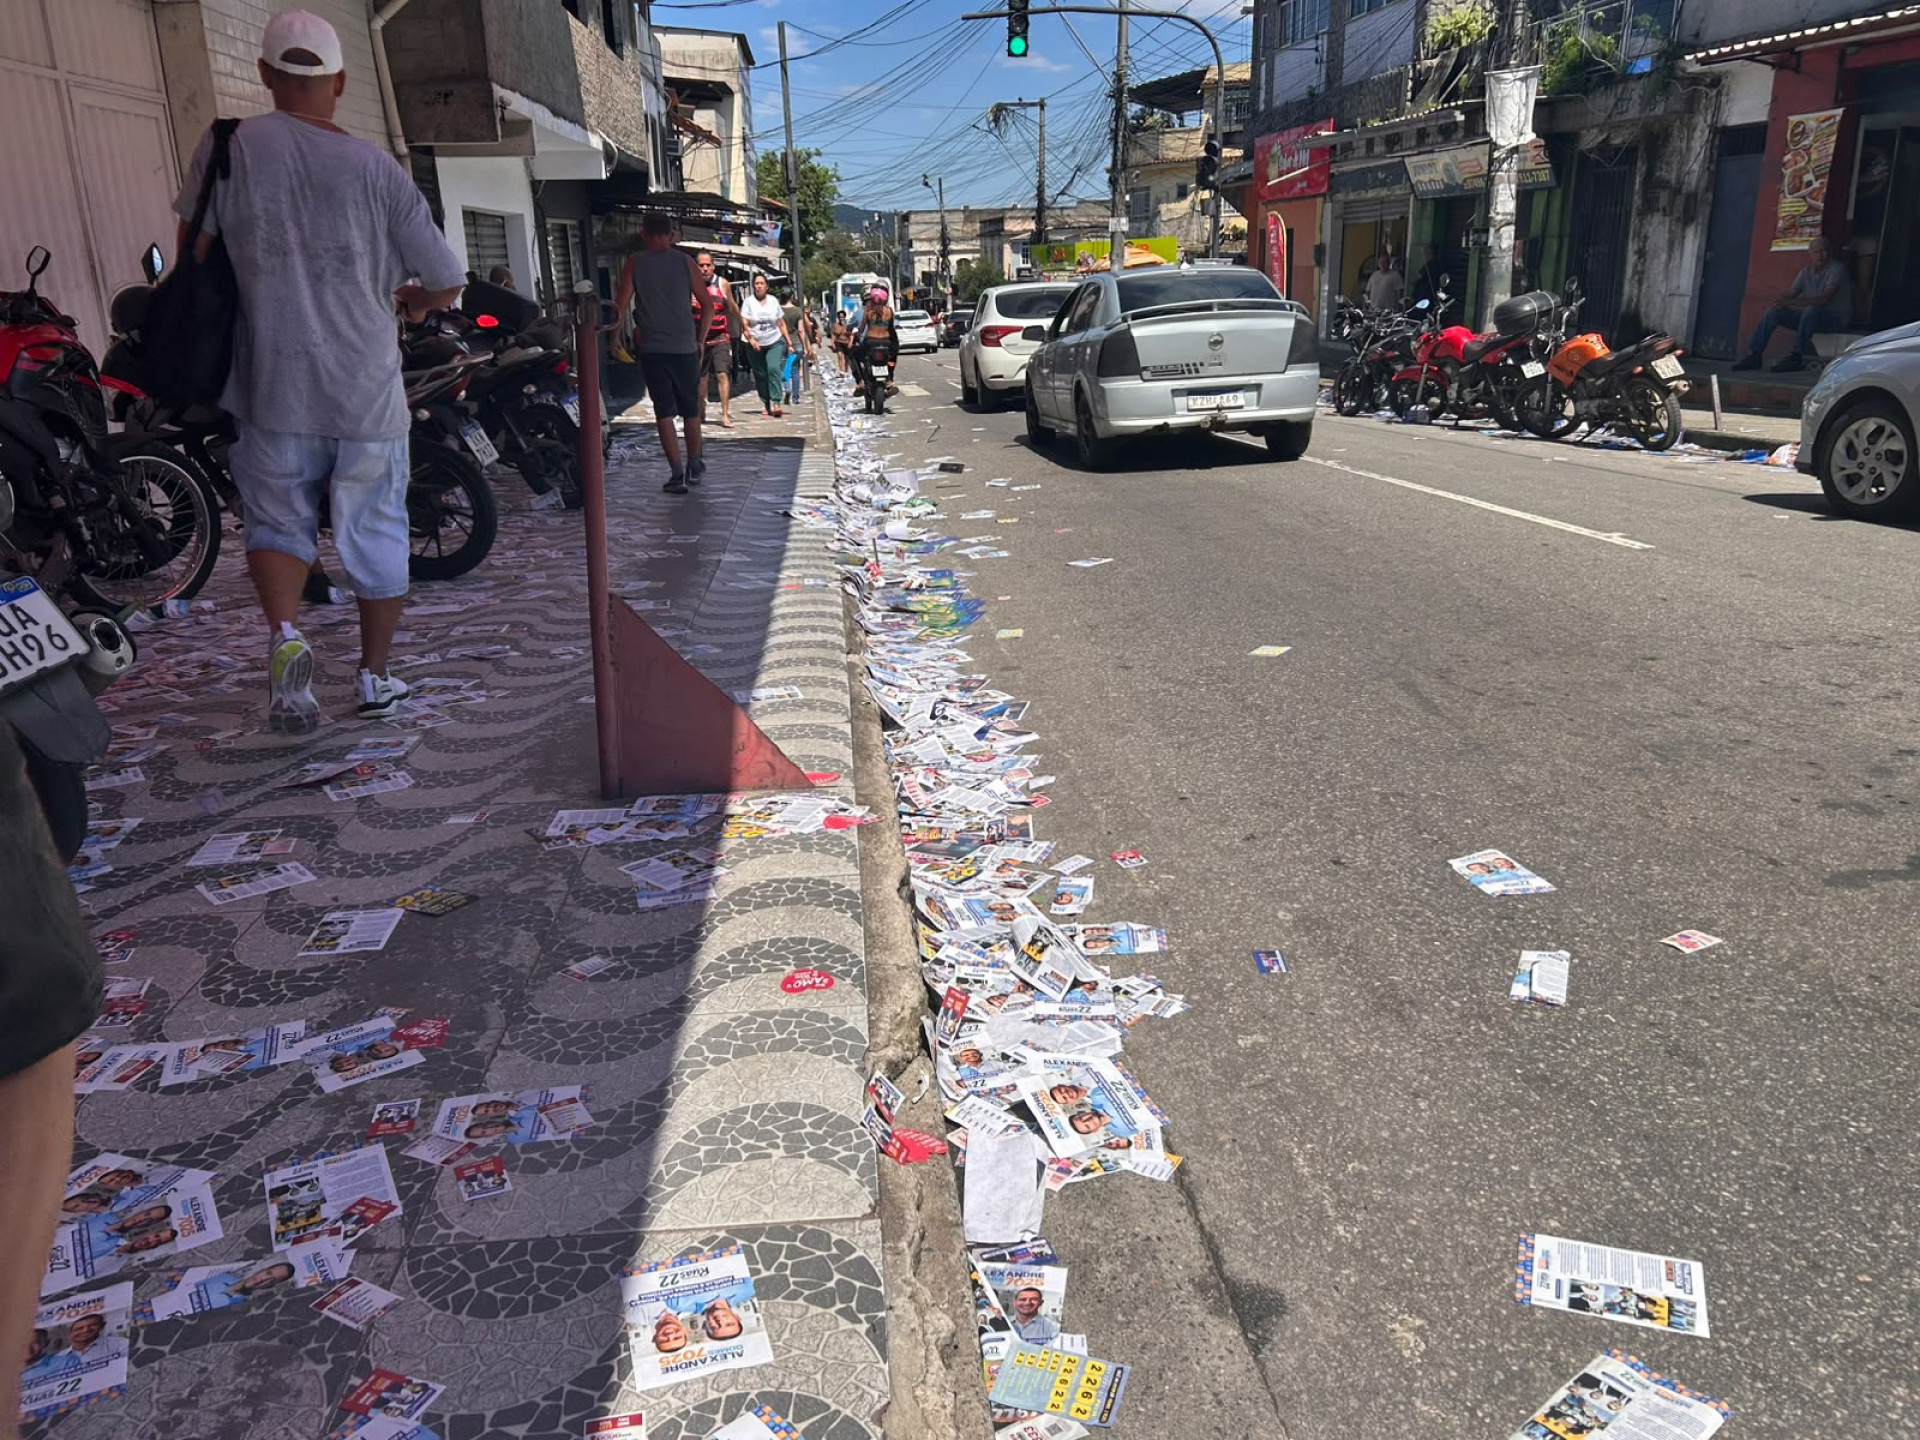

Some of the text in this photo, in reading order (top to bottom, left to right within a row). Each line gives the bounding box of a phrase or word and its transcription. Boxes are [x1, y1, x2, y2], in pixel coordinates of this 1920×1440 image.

[659, 1265, 710, 1288] 22 Ruas
[658, 1346, 705, 1368] 7025
[660, 1350, 745, 1375] ALEXANDRE
[56, 1377, 82, 1396] 22
